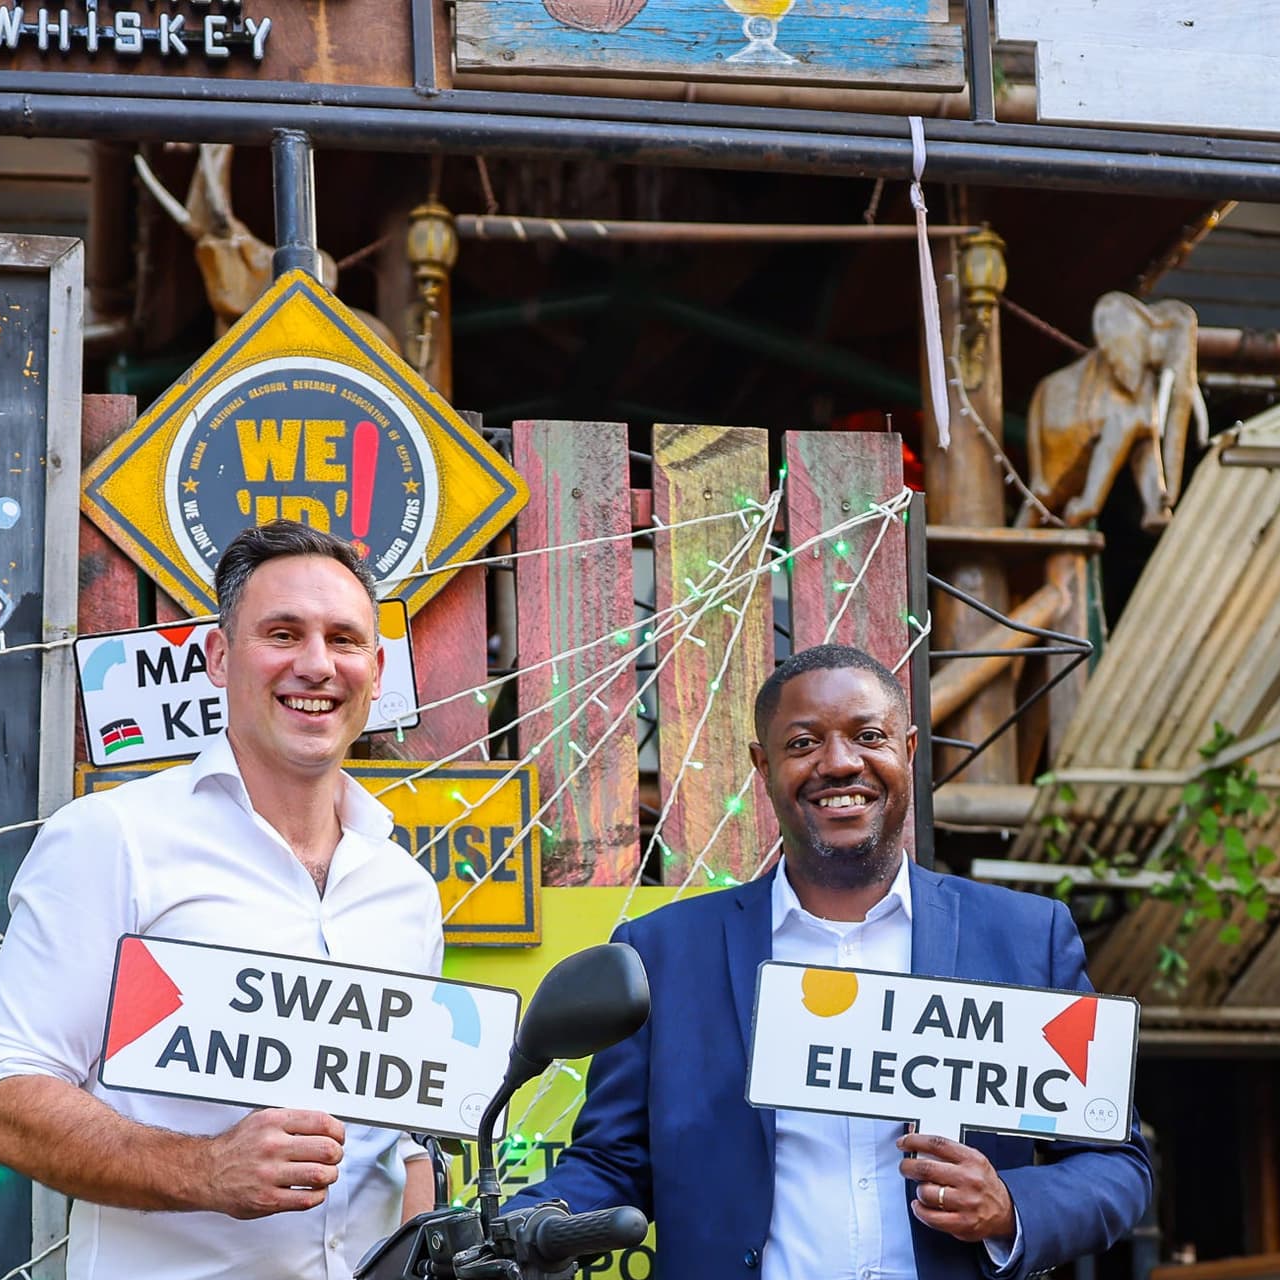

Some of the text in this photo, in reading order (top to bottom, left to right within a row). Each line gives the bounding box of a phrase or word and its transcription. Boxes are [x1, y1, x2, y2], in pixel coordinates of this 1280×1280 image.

[235, 419, 347, 482] WE
[183, 500, 200, 520] WE
[375, 498, 420, 573] UNDER 18YRS
[228, 967, 413, 1033] SWAP
[881, 989, 1004, 1043] I AM
[155, 1025, 448, 1107] AND RIDE
[805, 1044, 1071, 1113] ELECTRIC
